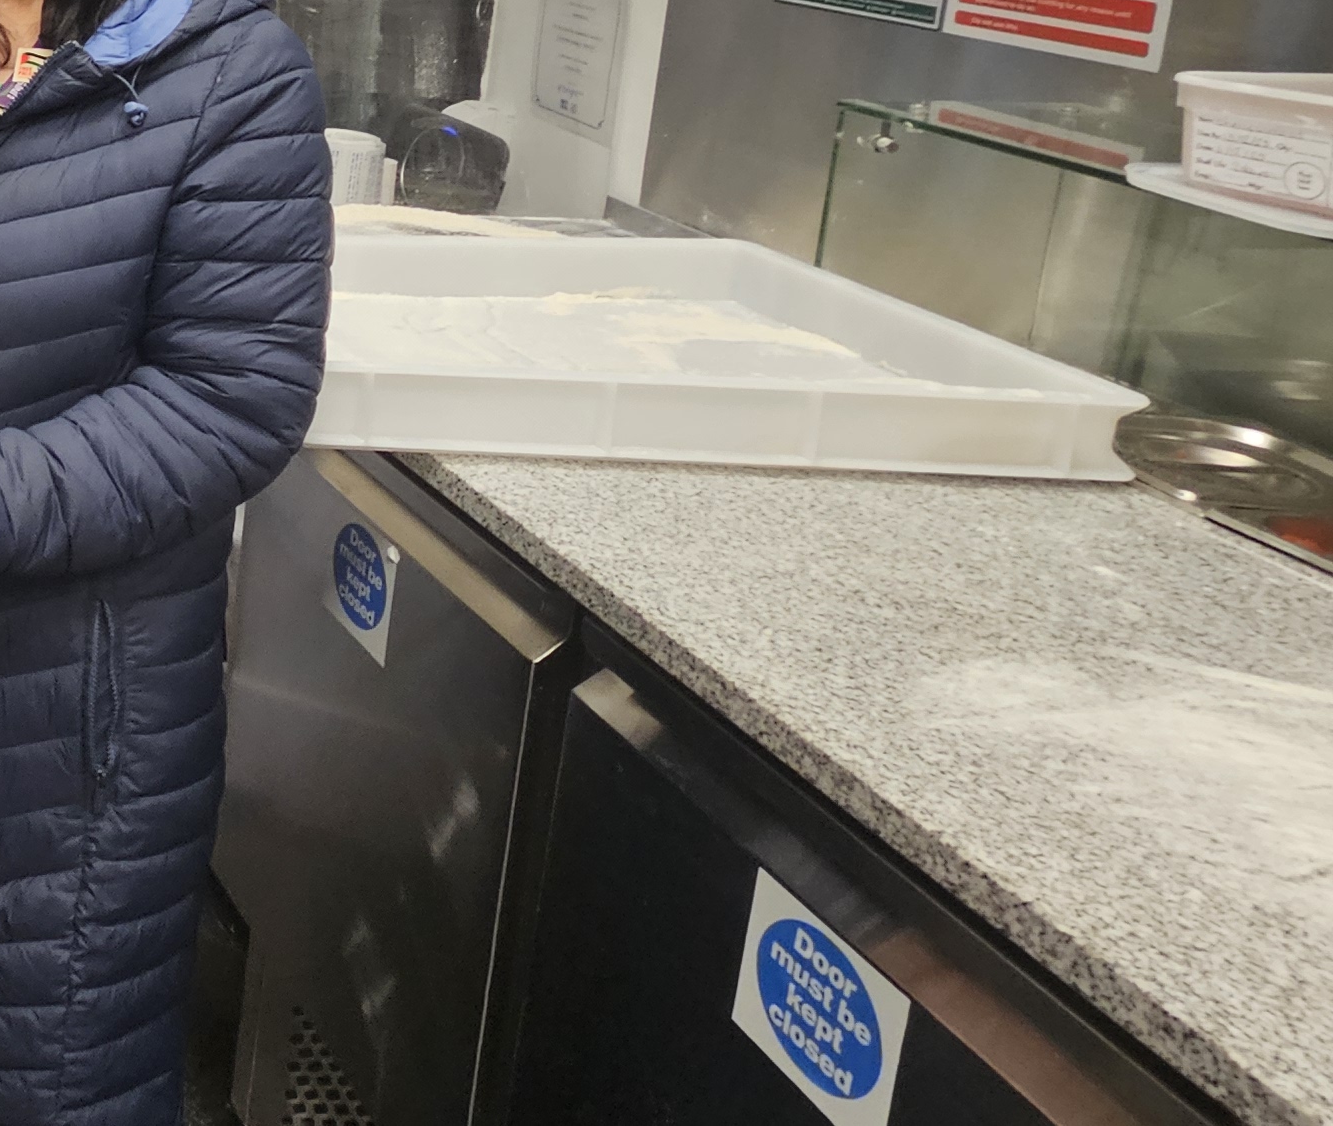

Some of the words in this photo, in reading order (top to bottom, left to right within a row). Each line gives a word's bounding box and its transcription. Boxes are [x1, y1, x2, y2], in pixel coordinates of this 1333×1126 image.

[339, 543, 367, 577] must
[367, 565, 383, 591] be
[349, 528, 376, 563] Door
[339, 583, 375, 627] closed
[346, 565, 371, 602] kept
[794, 927, 858, 999] Door
[770, 940, 834, 1013] must
[837, 999, 872, 1047] be
[786, 982, 844, 1055] kept
[768, 1003, 854, 1097] closed
